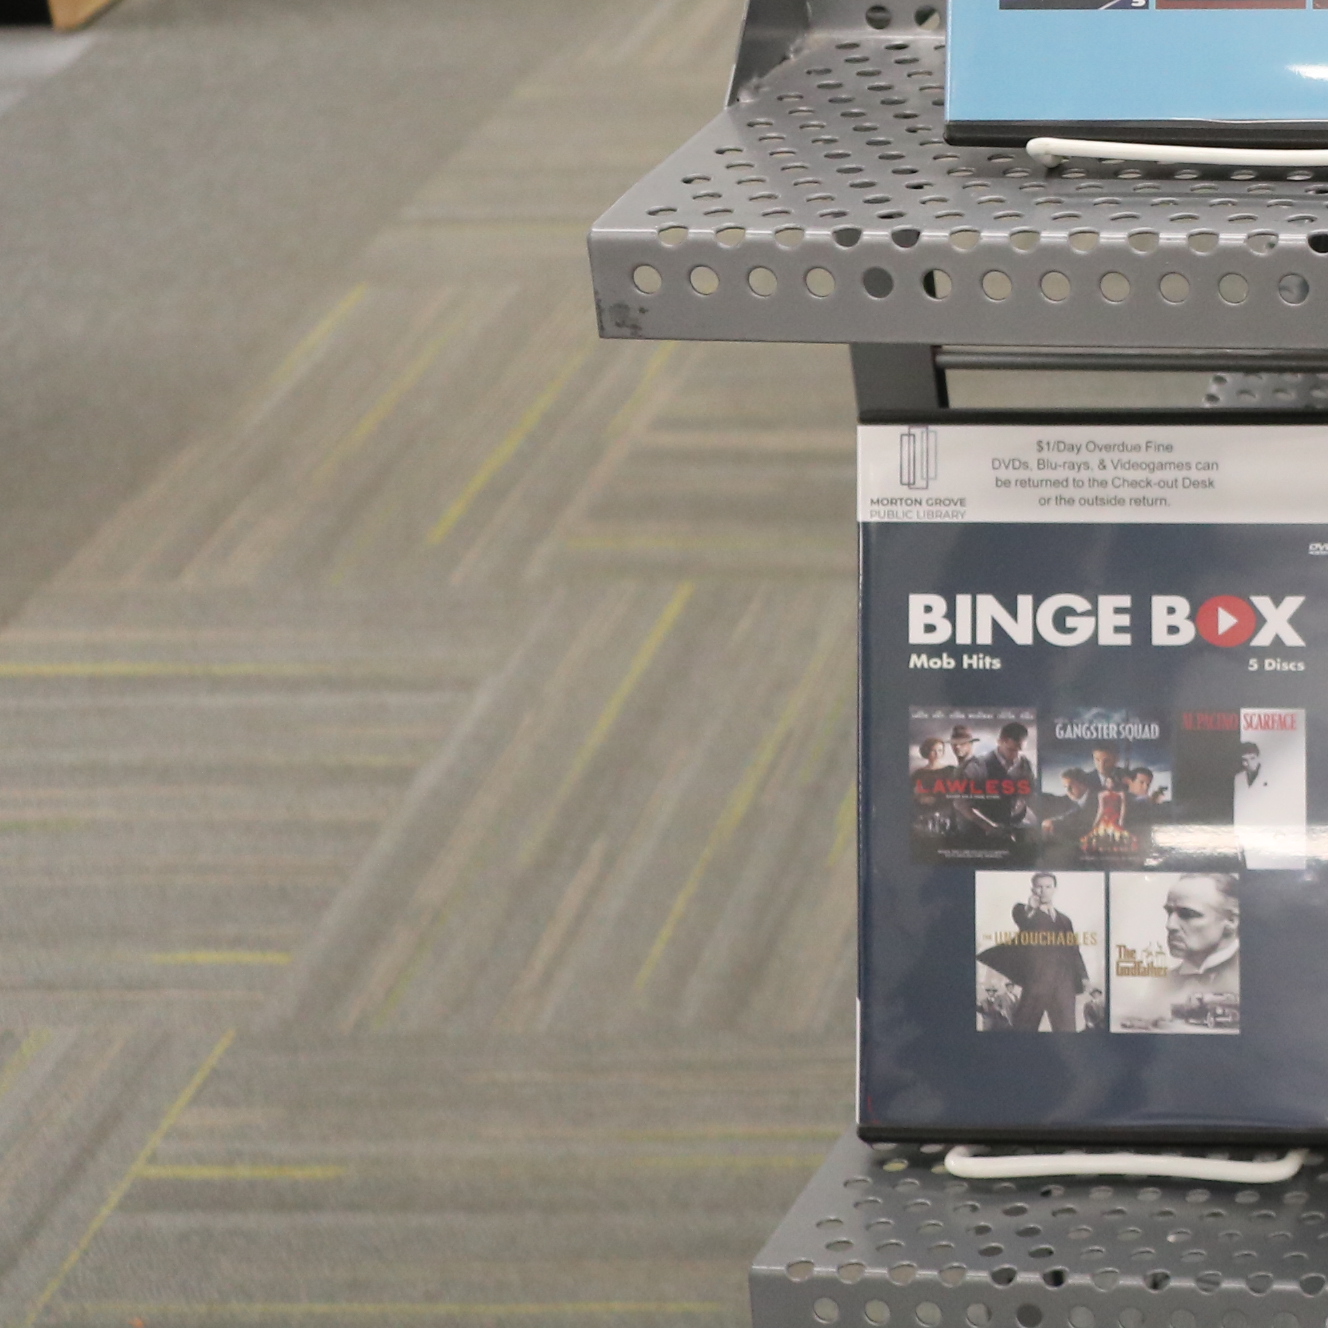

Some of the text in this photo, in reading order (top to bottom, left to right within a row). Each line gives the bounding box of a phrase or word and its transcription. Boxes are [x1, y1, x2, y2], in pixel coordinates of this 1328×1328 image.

[909, 594, 1306, 647] BINGE BOX
[910, 654, 1001, 670] Mob Hits
[1249, 659, 1305, 671] 5 Discs
[1243, 713, 1297, 730] SCARFACE
[1056, 723, 1160, 741] GANGSTER SQUAD
[916, 779, 1031, 795] LAWLESS
[994, 932, 1097, 946] UNTOUCHABLES
